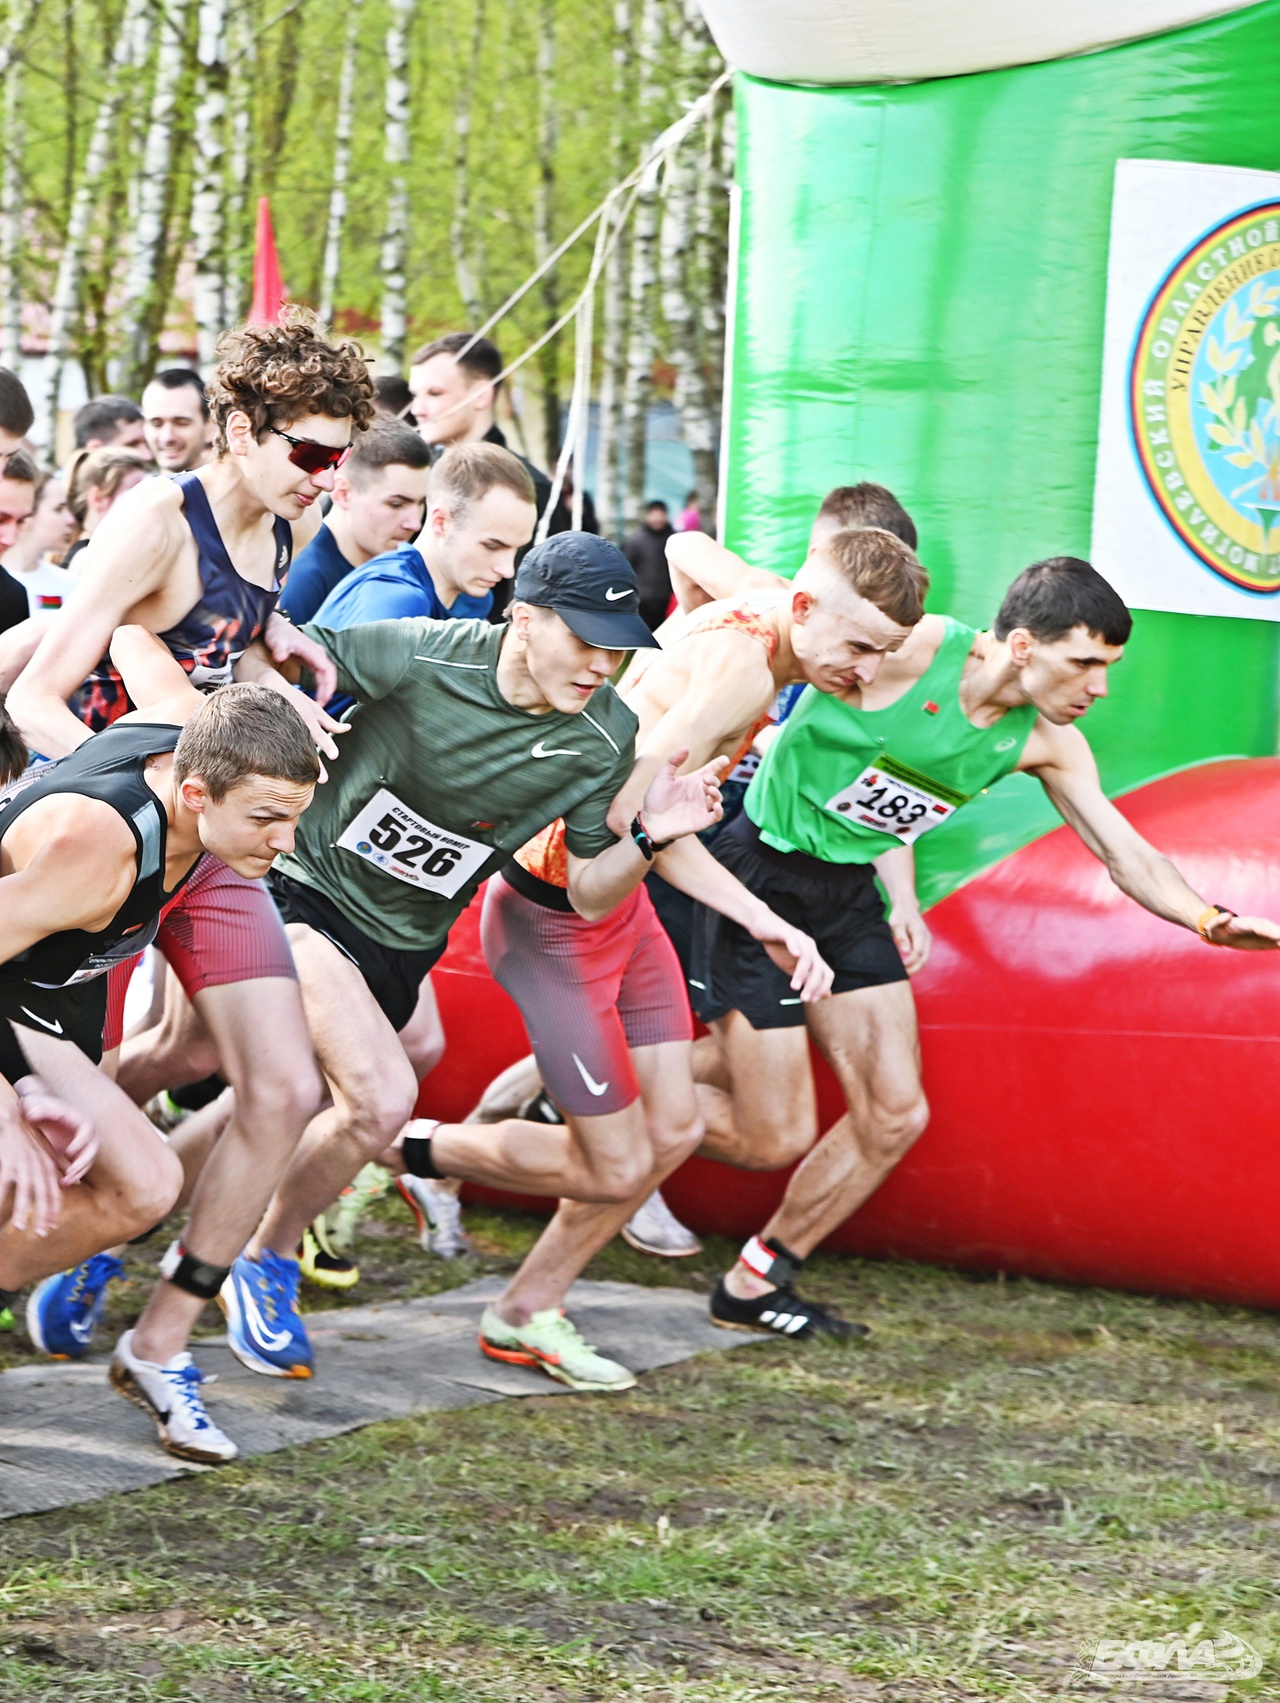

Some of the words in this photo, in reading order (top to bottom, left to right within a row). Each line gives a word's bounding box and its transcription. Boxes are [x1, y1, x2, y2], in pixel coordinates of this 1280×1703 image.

[856, 787, 927, 824] 183
[368, 812, 463, 877] 526
[392, 807, 442, 841] СТАРТОВЫЙ
[440, 835, 471, 850] НОМЕР
